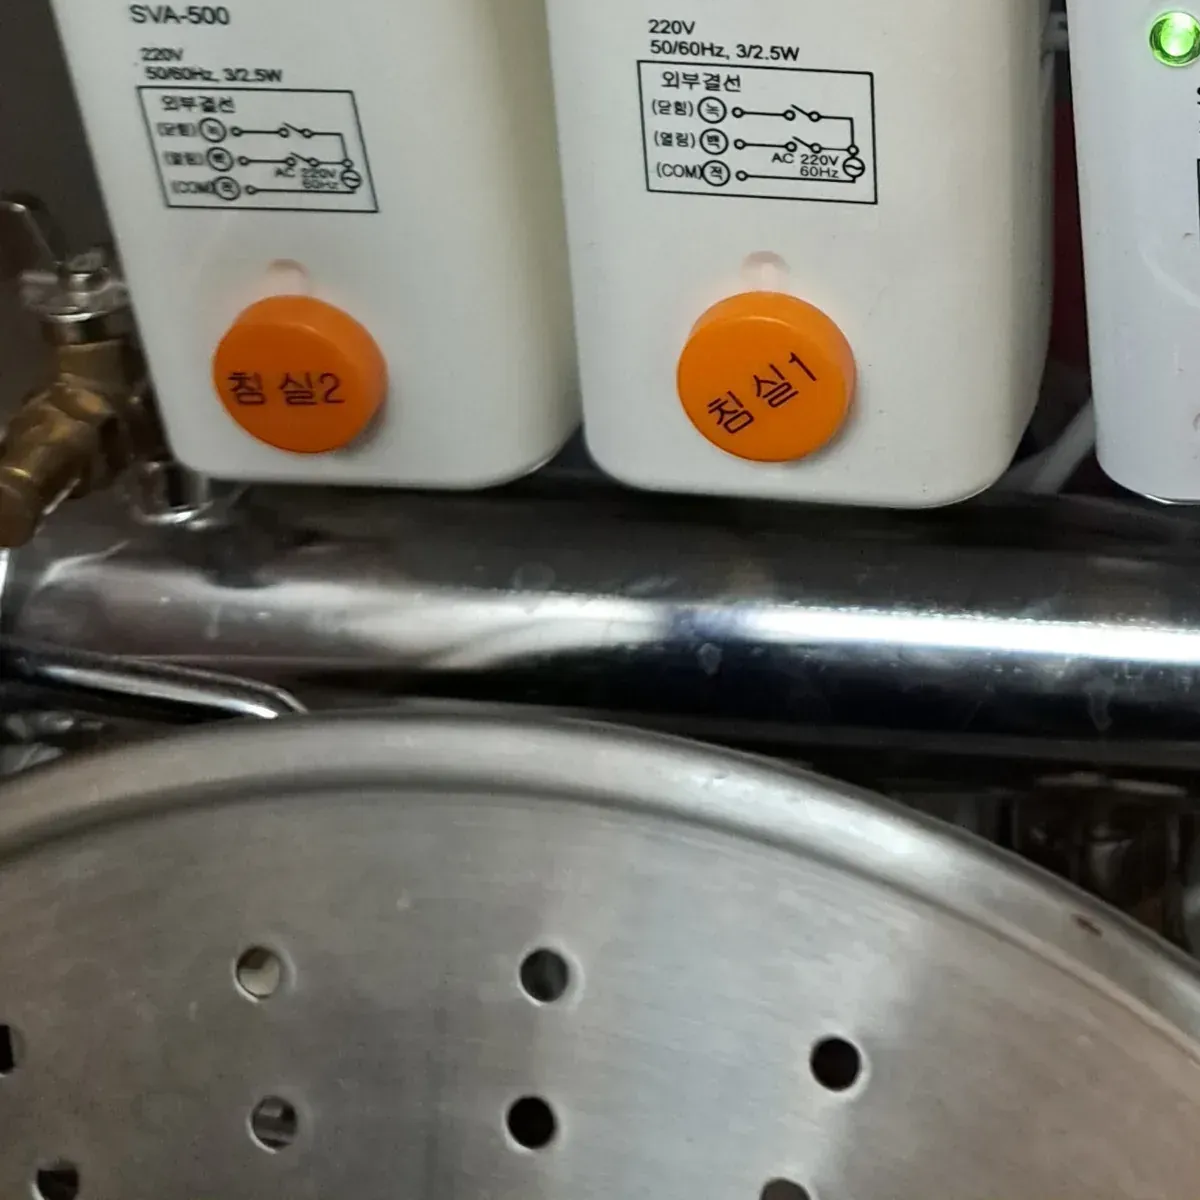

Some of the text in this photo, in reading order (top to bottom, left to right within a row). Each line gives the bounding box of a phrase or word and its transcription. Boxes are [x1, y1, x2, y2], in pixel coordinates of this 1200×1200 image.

[129, 3, 230, 25] SVA-500
[648, 19, 696, 35] 220V
[140, 47, 184, 61] 220V
[650, 40, 800, 61] 50/60Hz, 3/2.5W
[661, 70, 741, 92] 외부결선
[161, 95, 236, 113] 외부결선
[771, 153, 839, 166] AC 220V
[656, 162, 703, 179] (COM)
[800, 166, 839, 178] 60Hz
[227, 371, 346, 406] 침실2
[707, 351, 818, 435] 침실1
